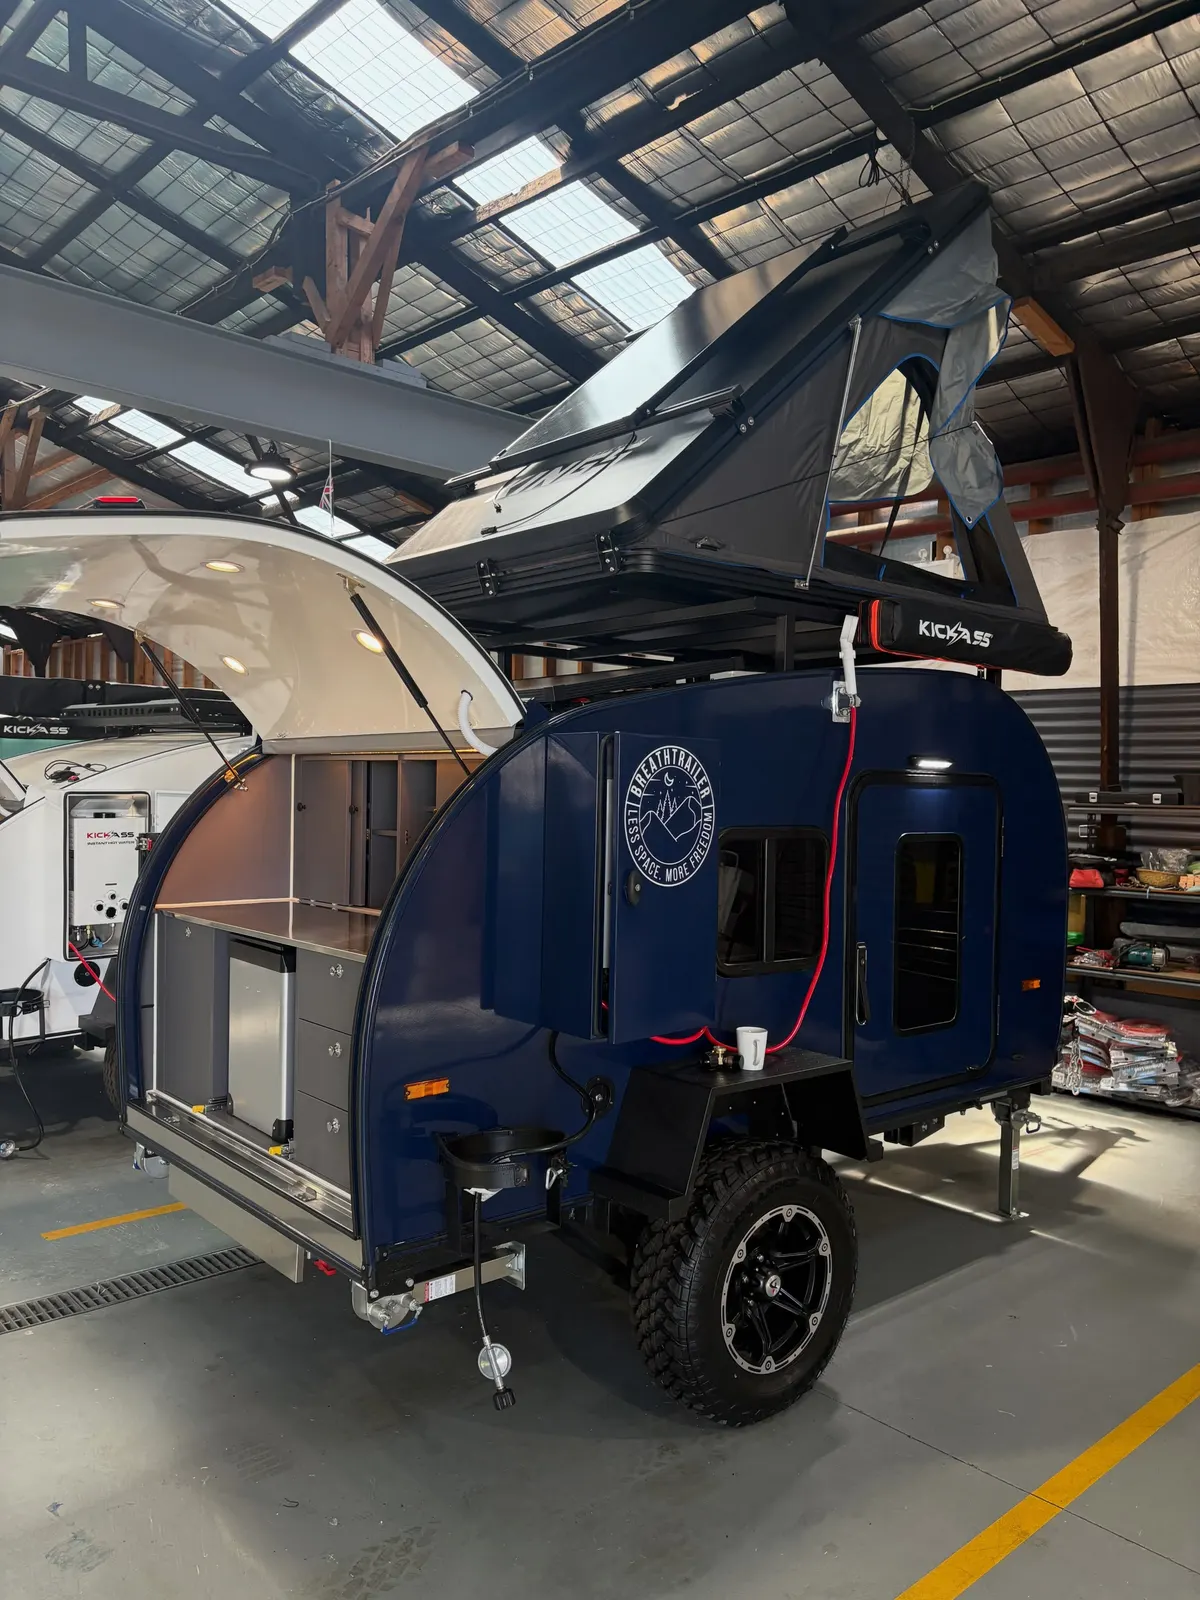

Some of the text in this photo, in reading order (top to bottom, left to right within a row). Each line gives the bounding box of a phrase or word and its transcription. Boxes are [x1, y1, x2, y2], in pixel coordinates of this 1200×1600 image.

[918, 619, 993, 648] KICKASS
[3, 724, 70, 736] KICKASS
[630, 748, 711, 799] BREATHTRAILER
[86, 830, 135, 839] KICKASS
[627, 809, 713, 882] LESS SPACE. MORE FREEDOM
